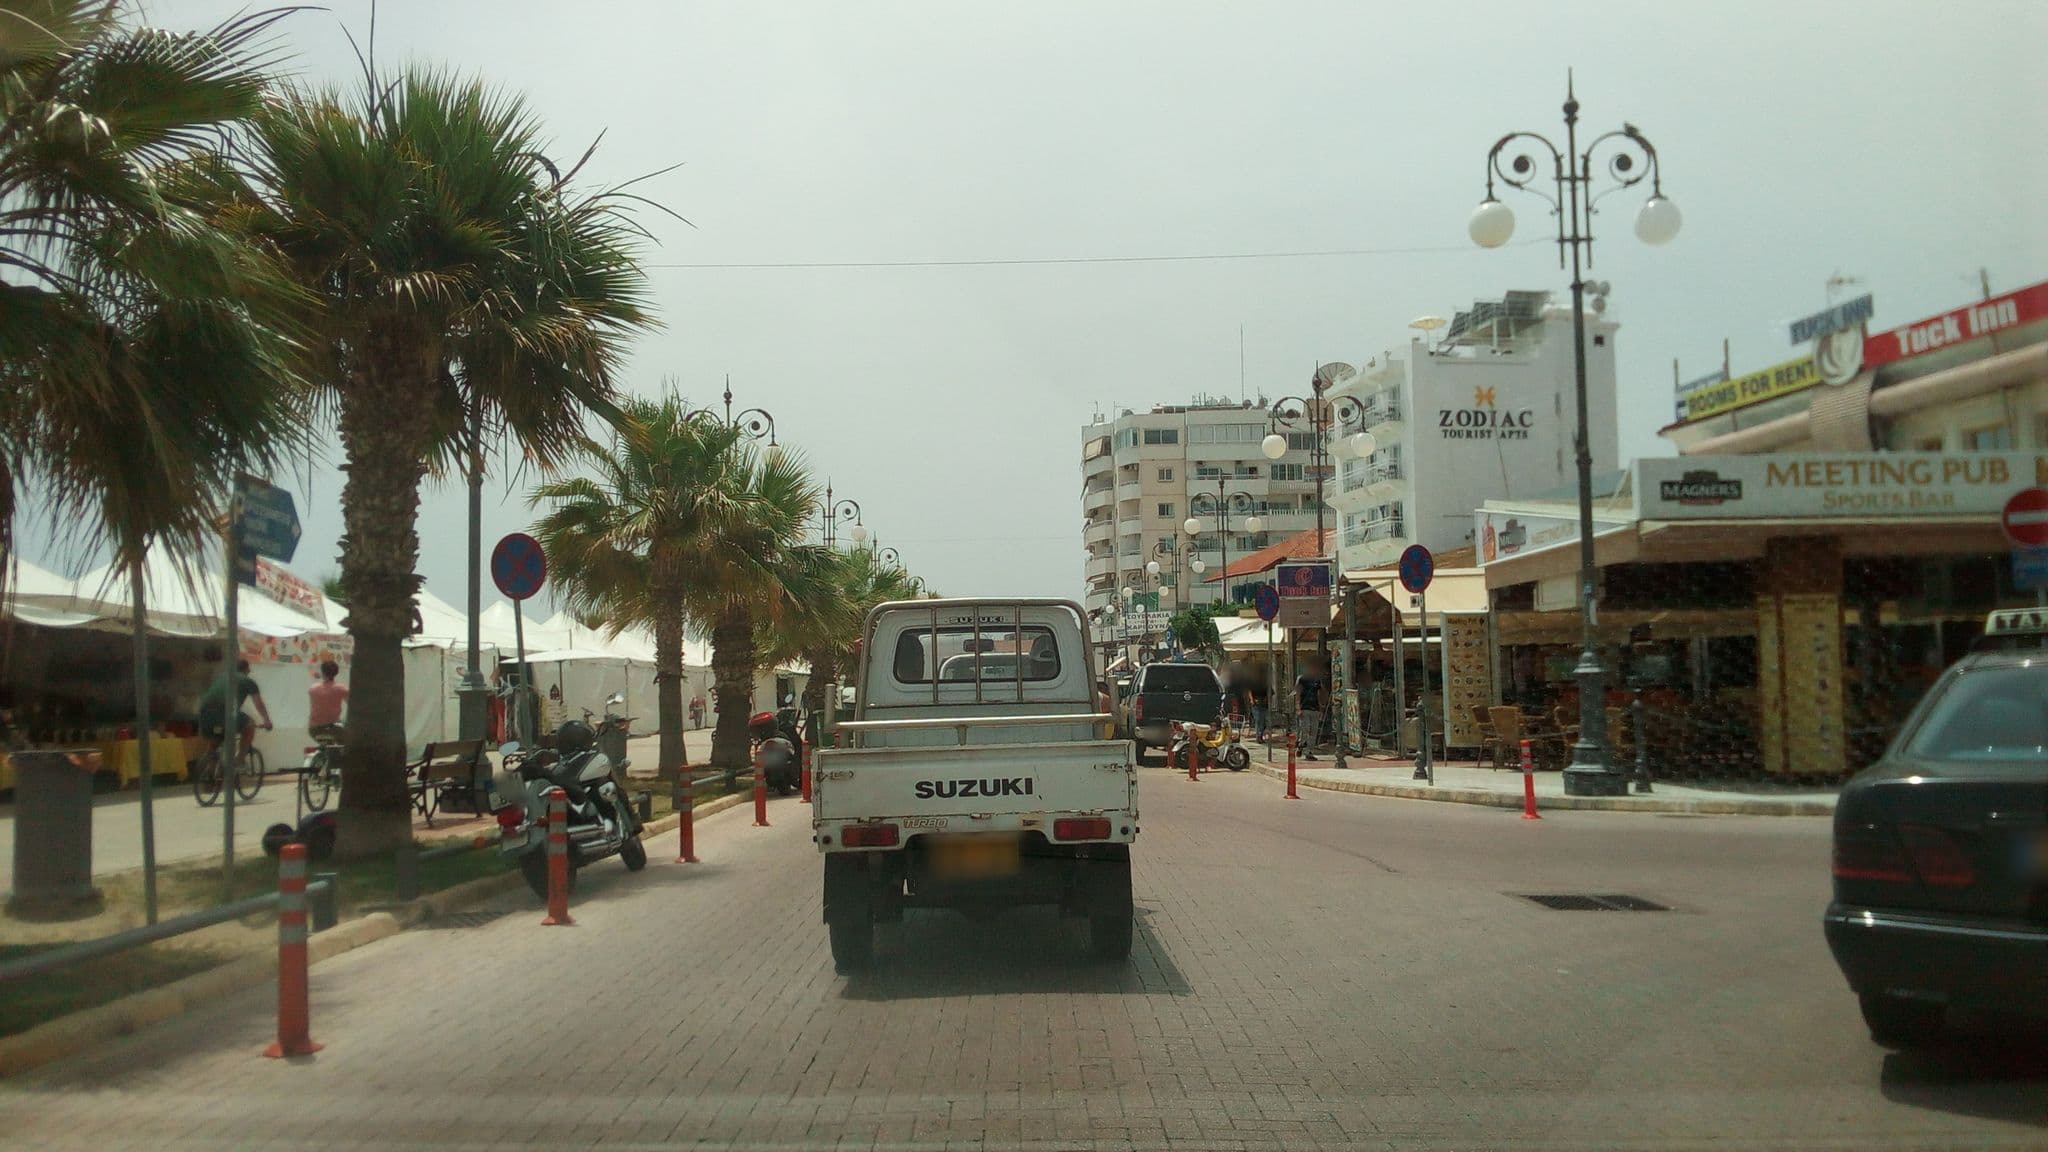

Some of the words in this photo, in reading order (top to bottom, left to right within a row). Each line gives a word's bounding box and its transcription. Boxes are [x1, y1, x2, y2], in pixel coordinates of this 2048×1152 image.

[1895, 315, 1961, 355] Tuck
[1968, 298, 2018, 336] Inn
[1689, 385, 1737, 414] ROOMS
[1741, 374, 1770, 398] FOR
[1774, 360, 1816, 386] RENT
[1439, 409, 1533, 428] ZODIAC
[1442, 429, 1493, 439] TOURIST
[1500, 430, 1528, 439] APTS
[1766, 460, 1932, 487] MEETING
[1942, 457, 2010, 485] PUB
[1909, 491, 1954, 508] BAR
[949, 615, 1005, 624] SUZUKI
[915, 778, 1033, 799] SUZUKI
[903, 817, 948, 829] TURBO
